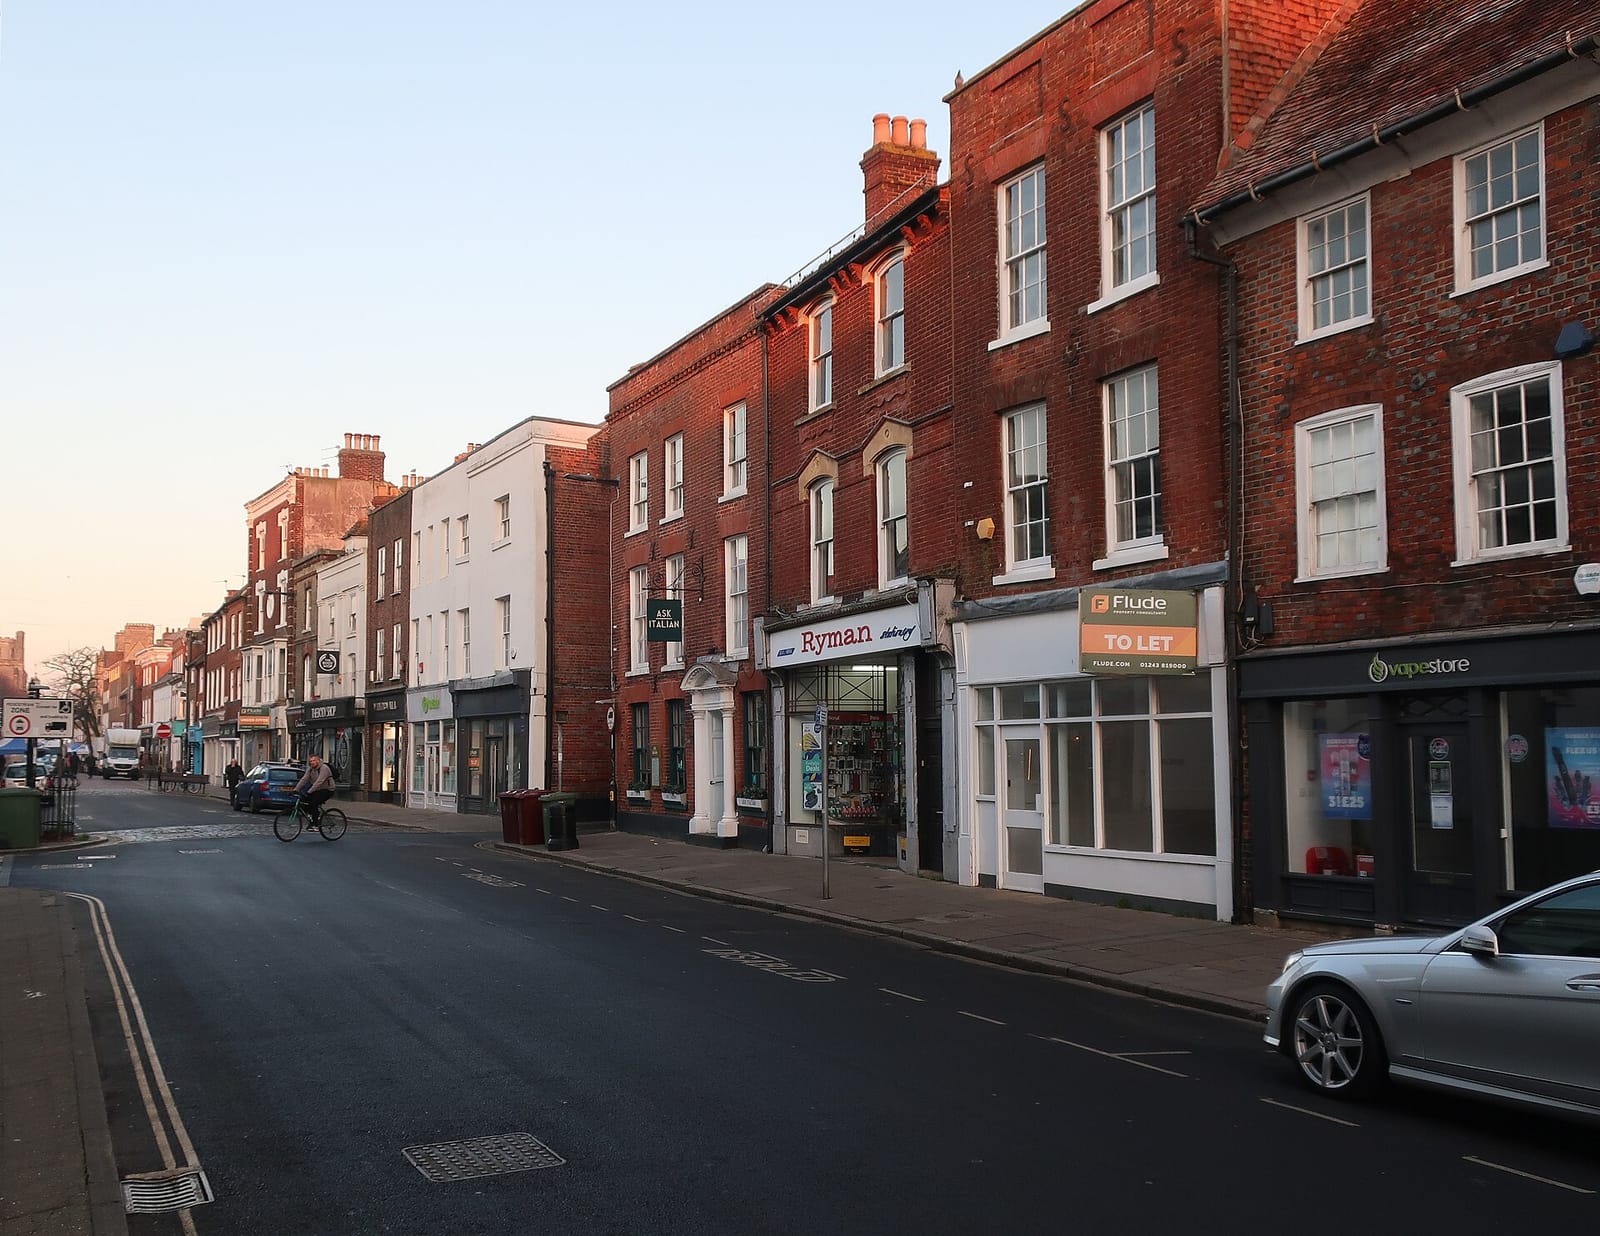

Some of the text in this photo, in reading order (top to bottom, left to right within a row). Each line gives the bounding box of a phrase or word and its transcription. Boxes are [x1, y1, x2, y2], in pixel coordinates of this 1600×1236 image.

[1113, 595, 1167, 610] Flude
[656, 609, 672, 618] ASK
[648, 620, 680, 628] ITALIAN
[801, 625, 873, 655] Ryman
[1103, 634, 1173, 652] TO LET
[1388, 658, 1470, 679] vapestore
